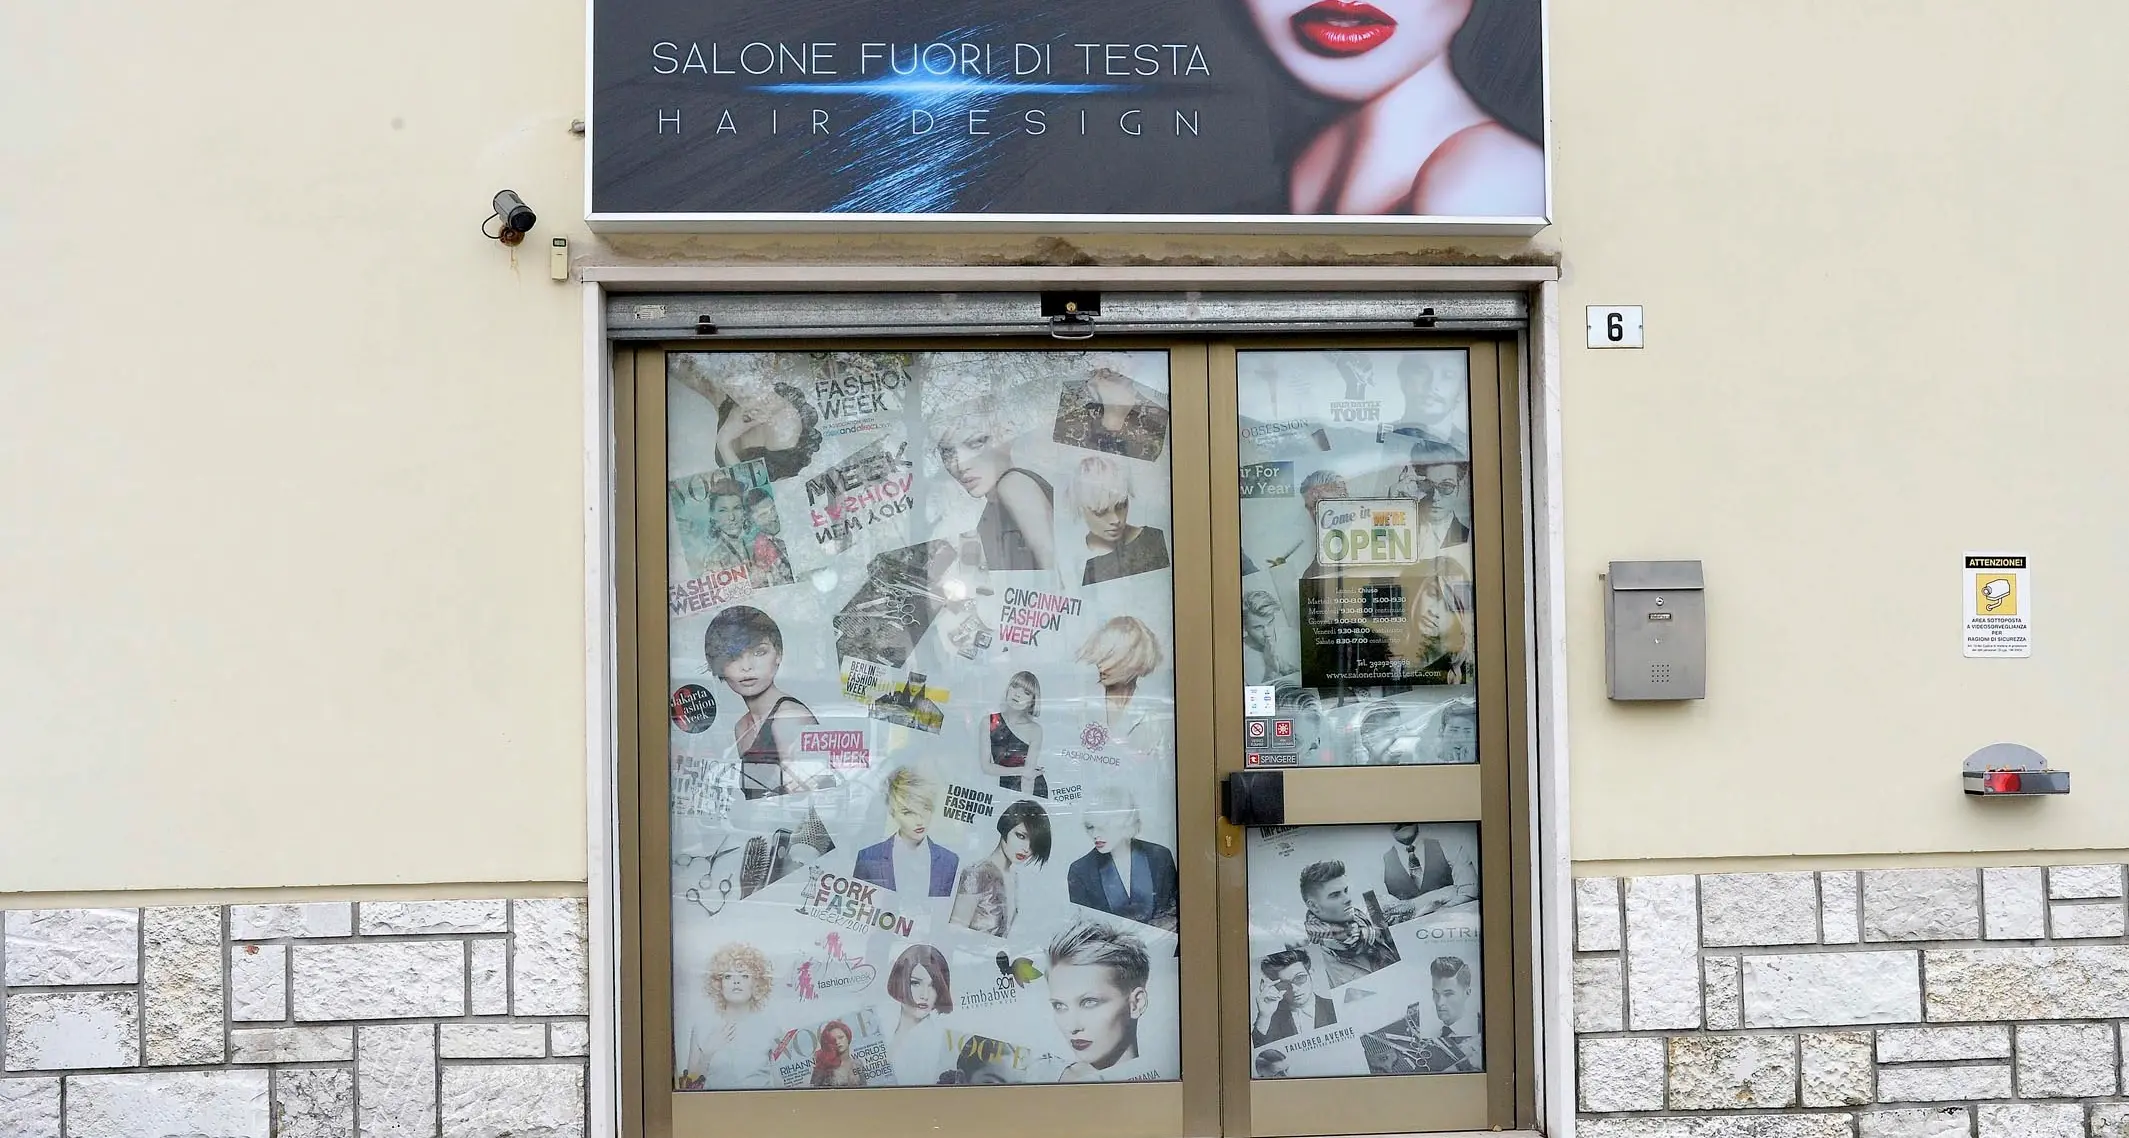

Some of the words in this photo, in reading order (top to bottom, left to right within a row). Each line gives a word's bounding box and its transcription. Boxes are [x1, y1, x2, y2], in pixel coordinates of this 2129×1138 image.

[652, 41, 837, 76] SALONE
[862, 41, 991, 76] FUORI
[1015, 42, 1051, 76] DI
[1075, 43, 1211, 77] TESTA
[658, 109, 830, 135] HAIR
[912, 109, 1199, 136] DESIGN
[1607, 312, 1623, 342] 6
[815, 368, 912, 400] FASHION
[817, 394, 888, 420] WEEK
[1330, 408, 1380, 422] TOUR
[1241, 419, 1309, 439] OBSESSION
[1255, 465, 1280, 478] For
[1257, 482, 1291, 495] Year
[1321, 509, 1356, 530] Come
[1360, 505, 1371, 519] in
[1371, 511, 1406, 527] WE'RE
[1322, 528, 1412, 561] OPEN
[1969, 558, 2023, 567] ATTENZIONE!
[669, 565, 748, 601] FASHION
[670, 586, 726, 616] WEEK
[1004, 587, 1082, 616] CINCINNATI
[1000, 605, 1061, 631] FASHION
[1000, 623, 1040, 647] WEEK
[850, 660, 877, 676] BERLIN
[847, 671, 878, 688] FASHION
[846, 681, 868, 697] WEEK
[671, 690, 708, 707] Jakarta
[683, 698, 715, 715] ashion
[803, 732, 861, 750] FASHION
[829, 750, 868, 765] WEEK
[1061, 749, 1120, 767] FASHIONMODE
[1260, 755, 1296, 764] SPINGERE
[947, 784, 993, 805] LONDON
[1051, 784, 1082, 796] TREVOR
[1054, 791, 1082, 801] SORBIE
[943, 806, 976, 824] WEEK
[945, 795, 994, 817] FASHION
[820, 873, 877, 905] CORK
[813, 888, 914, 937] FASHION
[960, 986, 1017, 1006] zimbabwe
[1285, 1036, 1322, 1053] TAILORED
[1324, 1026, 1355, 1042] AVENUE
[850, 1044, 886, 1060] WORLD'S
[864, 1051, 887, 1064] MOST
[780, 1058, 817, 1076] RIHANN
[852, 1059, 890, 1075] BEAUTIFUL
[864, 1066, 892, 1080] BODIES
